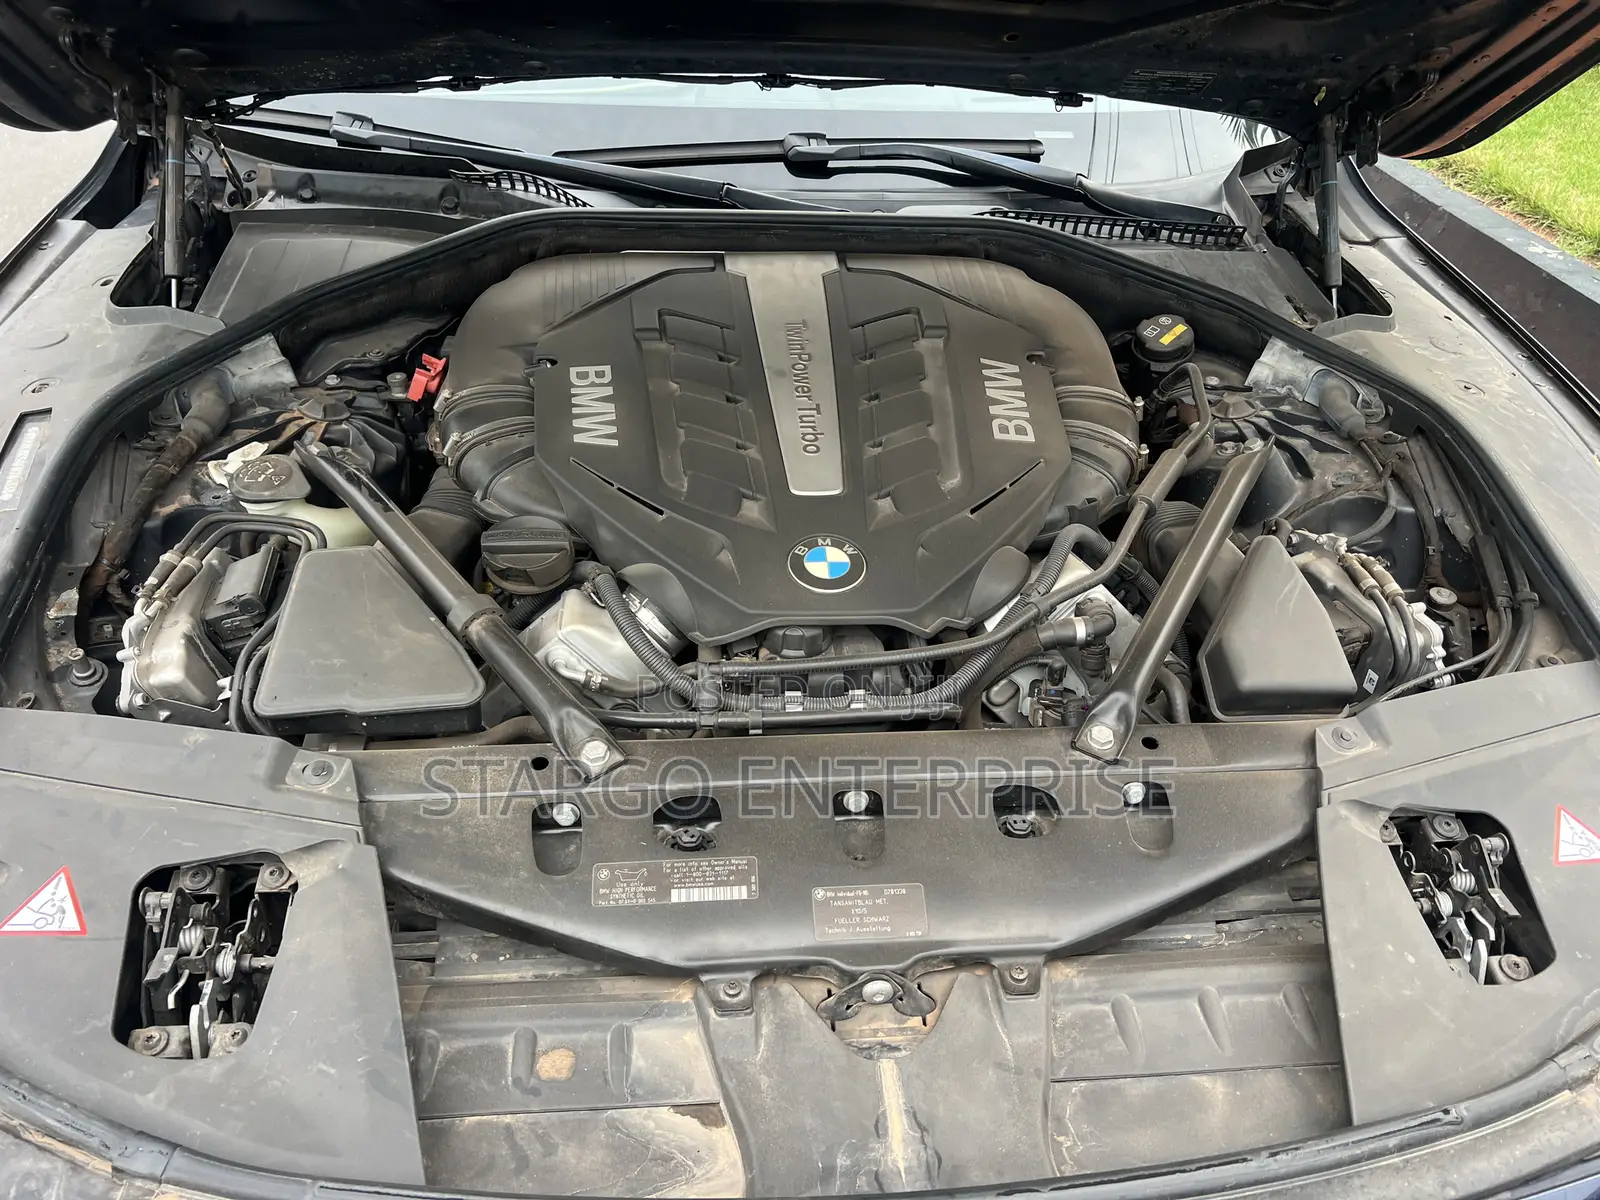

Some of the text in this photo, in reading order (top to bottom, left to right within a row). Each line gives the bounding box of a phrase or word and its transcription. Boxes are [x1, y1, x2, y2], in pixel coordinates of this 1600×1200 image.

[569, 364, 619, 447] BMW
[784, 319, 824, 456] TwinPower Turbo
[979, 357, 1036, 442] BMW
[794, 537, 858, 556] BMW
[830, 899, 873, 907] TANSANITBLAU
